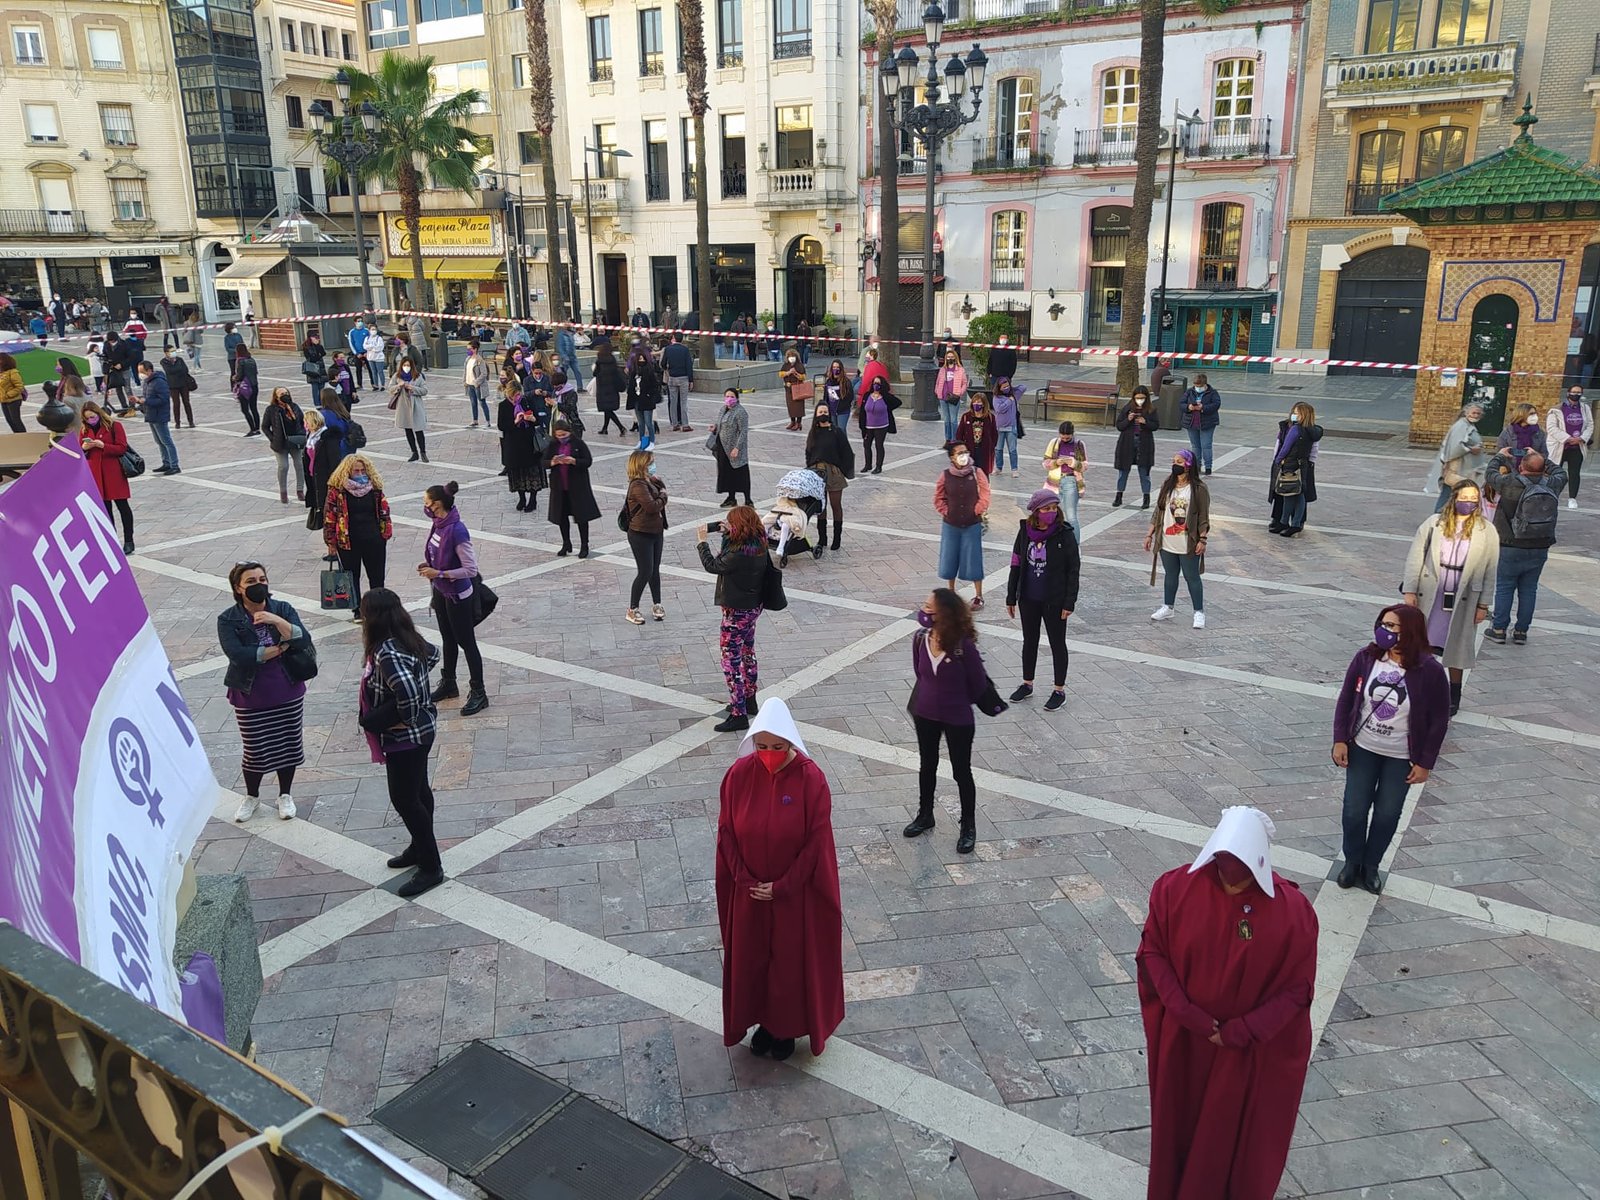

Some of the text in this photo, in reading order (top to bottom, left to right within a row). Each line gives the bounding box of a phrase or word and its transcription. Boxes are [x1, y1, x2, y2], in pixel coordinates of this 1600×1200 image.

[457, 218, 490, 231] Plaza
[98, 248, 176, 256] CAFETERIA
[107, 833, 158, 1008] SMO,
